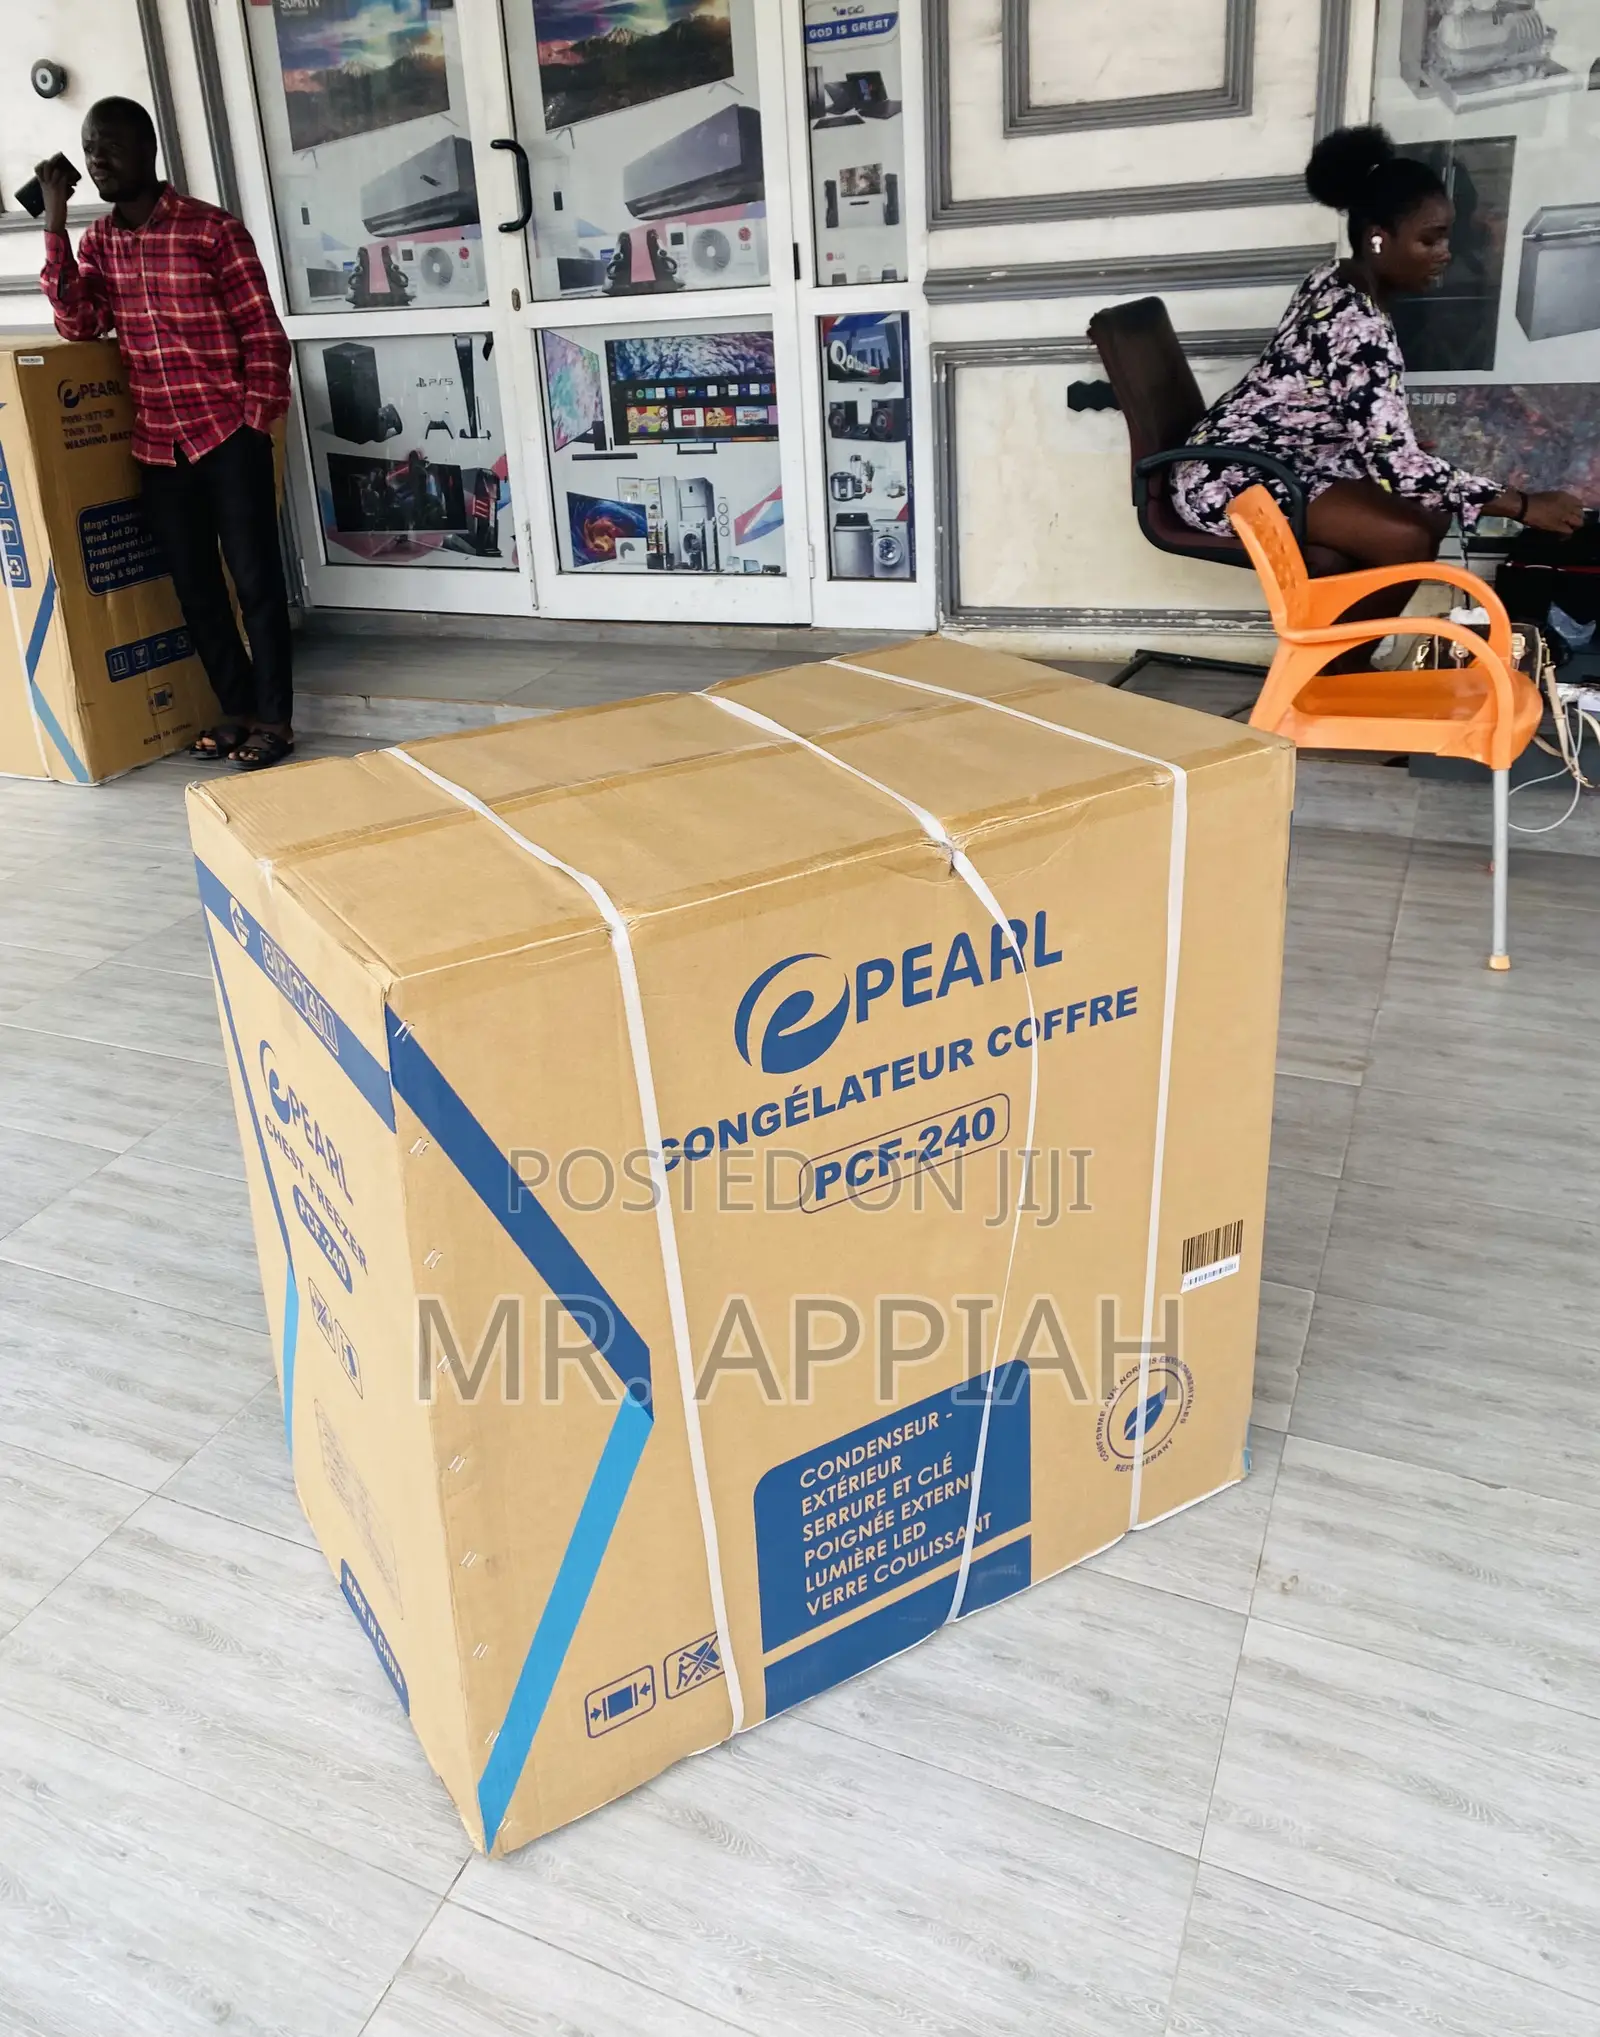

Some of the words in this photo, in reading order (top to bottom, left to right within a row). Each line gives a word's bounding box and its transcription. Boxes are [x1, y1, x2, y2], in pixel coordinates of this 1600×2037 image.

[809, 28, 833, 39] GOD
[836, 25, 848, 34] IS
[852, 19, 890, 32] GREAT
[1404, 392, 1457, 405] SUNG
[85, 532, 108, 545] Wind
[88, 539, 139, 559] Transparent
[89, 556, 126, 573] Program
[92, 571, 116, 585] Wash
[125, 564, 145, 577] Spin
[855, 910, 1063, 1024] PEARL
[987, 986, 1140, 1058] COFFRE
[287, 1084, 354, 1206] PEARL
[813, 1106, 997, 1202] PCF-240
[264, 1114, 305, 1179] CHEST
[307, 1171, 369, 1276] FREEZER
[297, 1192, 348, 1282] PCF-240
[1104, 1386, 1119, 1409] AUX
[1119, 1357, 1157, 1385] NORS
[799, 1411, 940, 1489] CONDENSEUR
[801, 1454, 903, 1517] EXTÉRIEUR
[802, 1487, 887, 1543] SERRURE
[892, 1475, 912, 1499] ET
[917, 1451, 953, 1486] CLÉ
[804, 1509, 896, 1568] POIGNÉE
[805, 1536, 888, 1593] LUMIÈRE
[893, 1520, 927, 1550] LED
[806, 1574, 868, 1617] VERRE
[874, 1511, 992, 1584] COULISSANT
[346, 1570, 366, 1617] MADE
[367, 1614, 378, 1640] IN
[377, 1634, 404, 1689] CHINA
